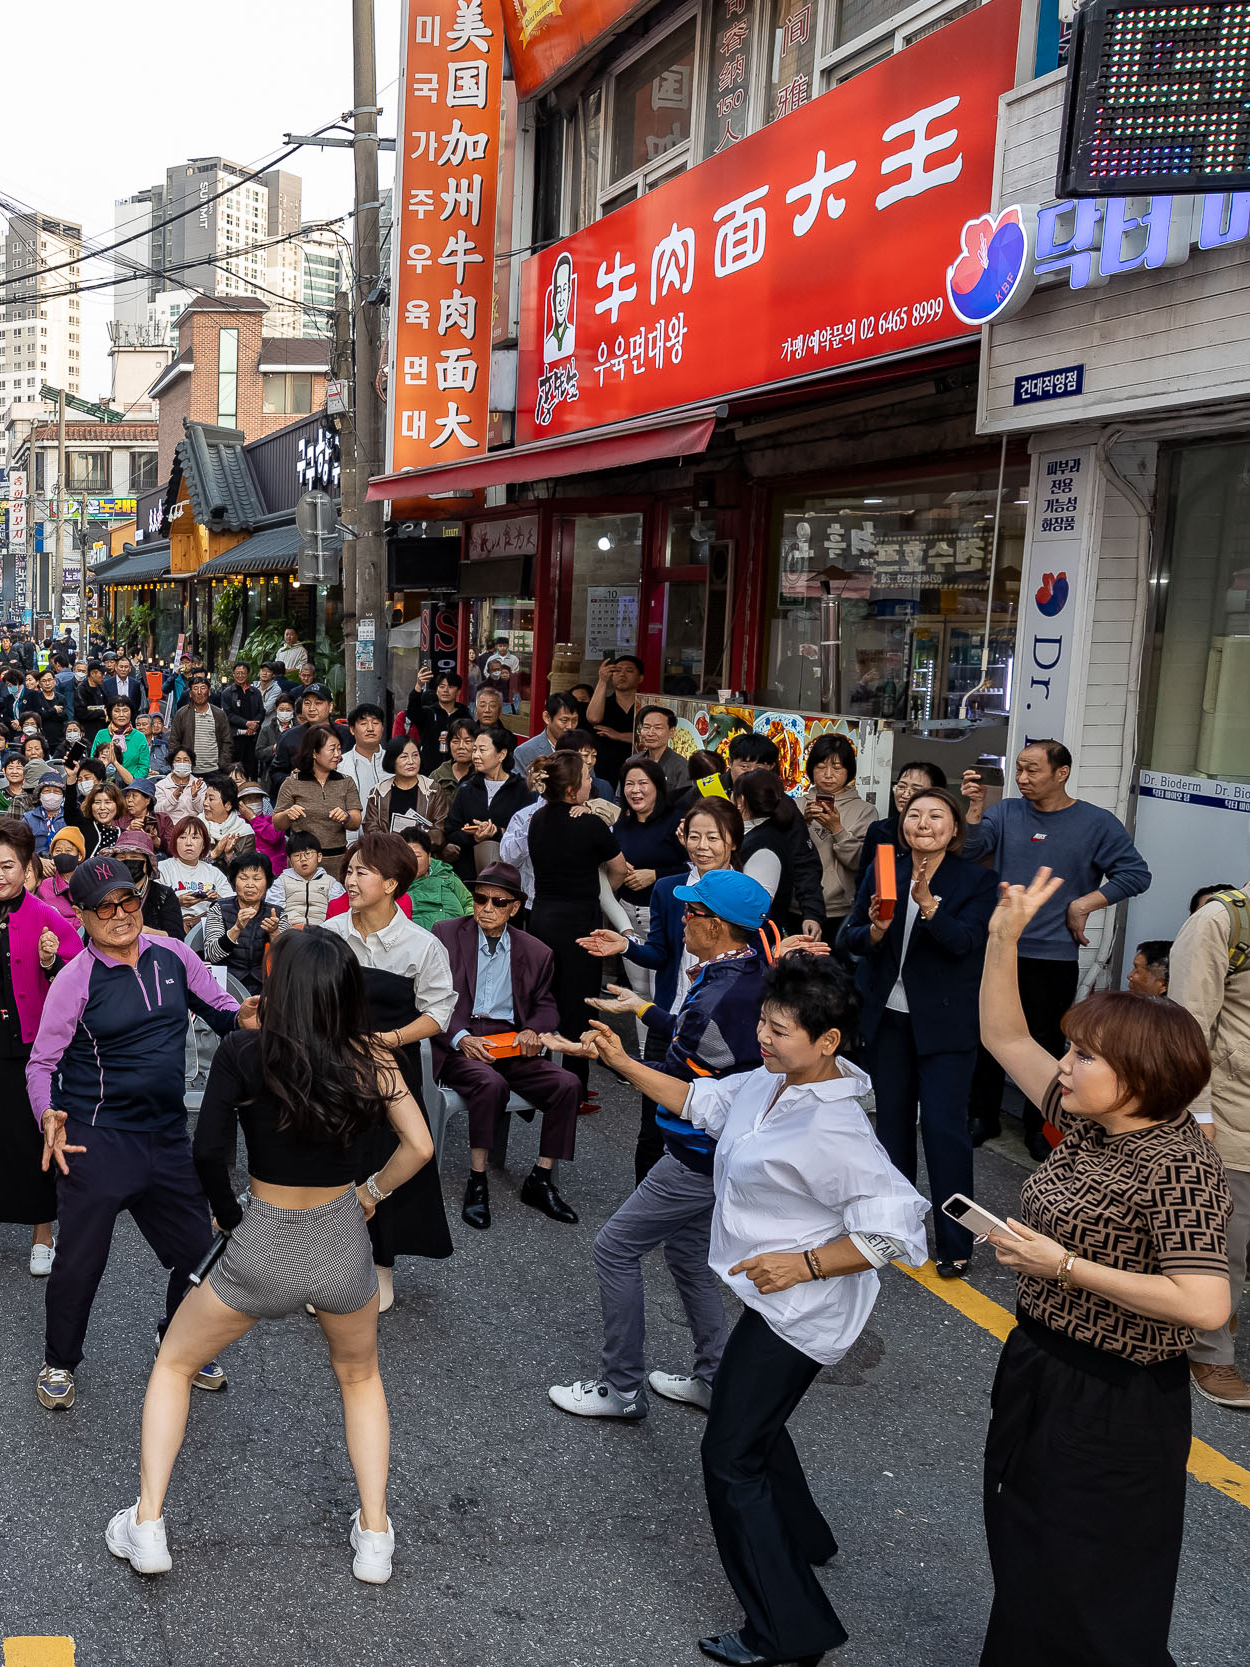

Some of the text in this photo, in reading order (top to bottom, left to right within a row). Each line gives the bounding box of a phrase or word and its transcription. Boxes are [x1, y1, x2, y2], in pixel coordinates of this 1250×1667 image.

[594, 96, 963, 325] 牛肉面大王
[994, 271, 1016, 304] KBF
[781, 297, 943, 362] 가맹/예약문의 02 6465 8999
[593, 312, 688, 388] 우육면대왕
[1020, 369, 1077, 399] 건대직영점
[1046, 458, 1081, 476] 피부과
[1050, 477, 1073, 494] 전용
[1043, 496, 1078, 514] 기능성
[1041, 515, 1076, 534] 화장품
[607, 590, 618, 599] 10
[1144, 773, 1202, 792] Dr. Bioderm
[1214, 783, 1230, 797] Dr.
